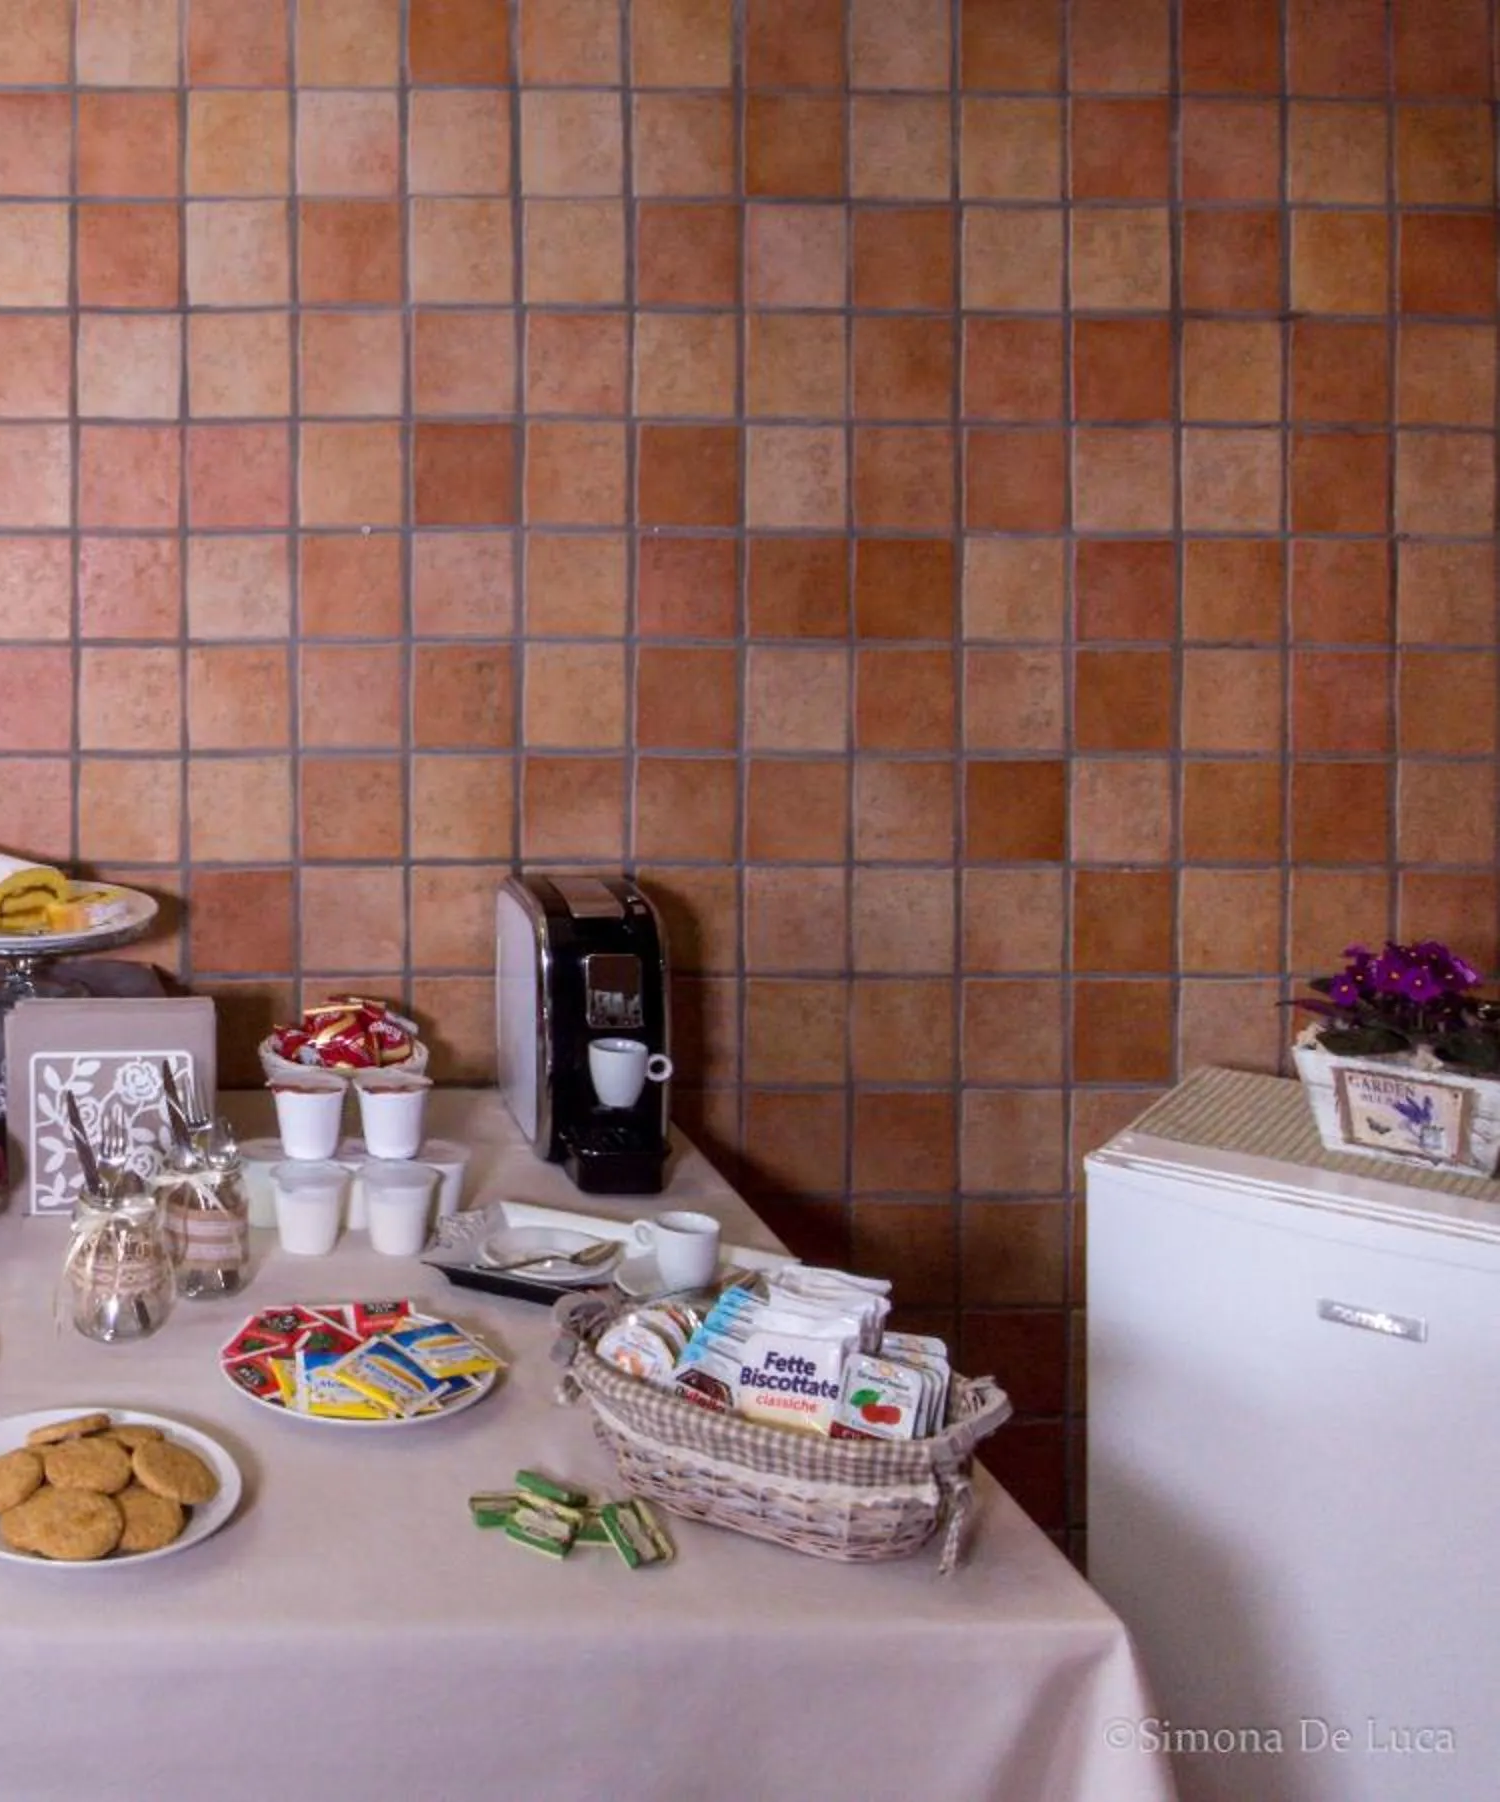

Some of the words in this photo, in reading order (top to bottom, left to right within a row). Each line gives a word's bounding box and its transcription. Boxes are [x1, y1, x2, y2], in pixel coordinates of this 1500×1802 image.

[763, 1350, 818, 1377] Fette
[739, 1366, 840, 1400] Biscottate
[755, 1393, 820, 1415] classiche
